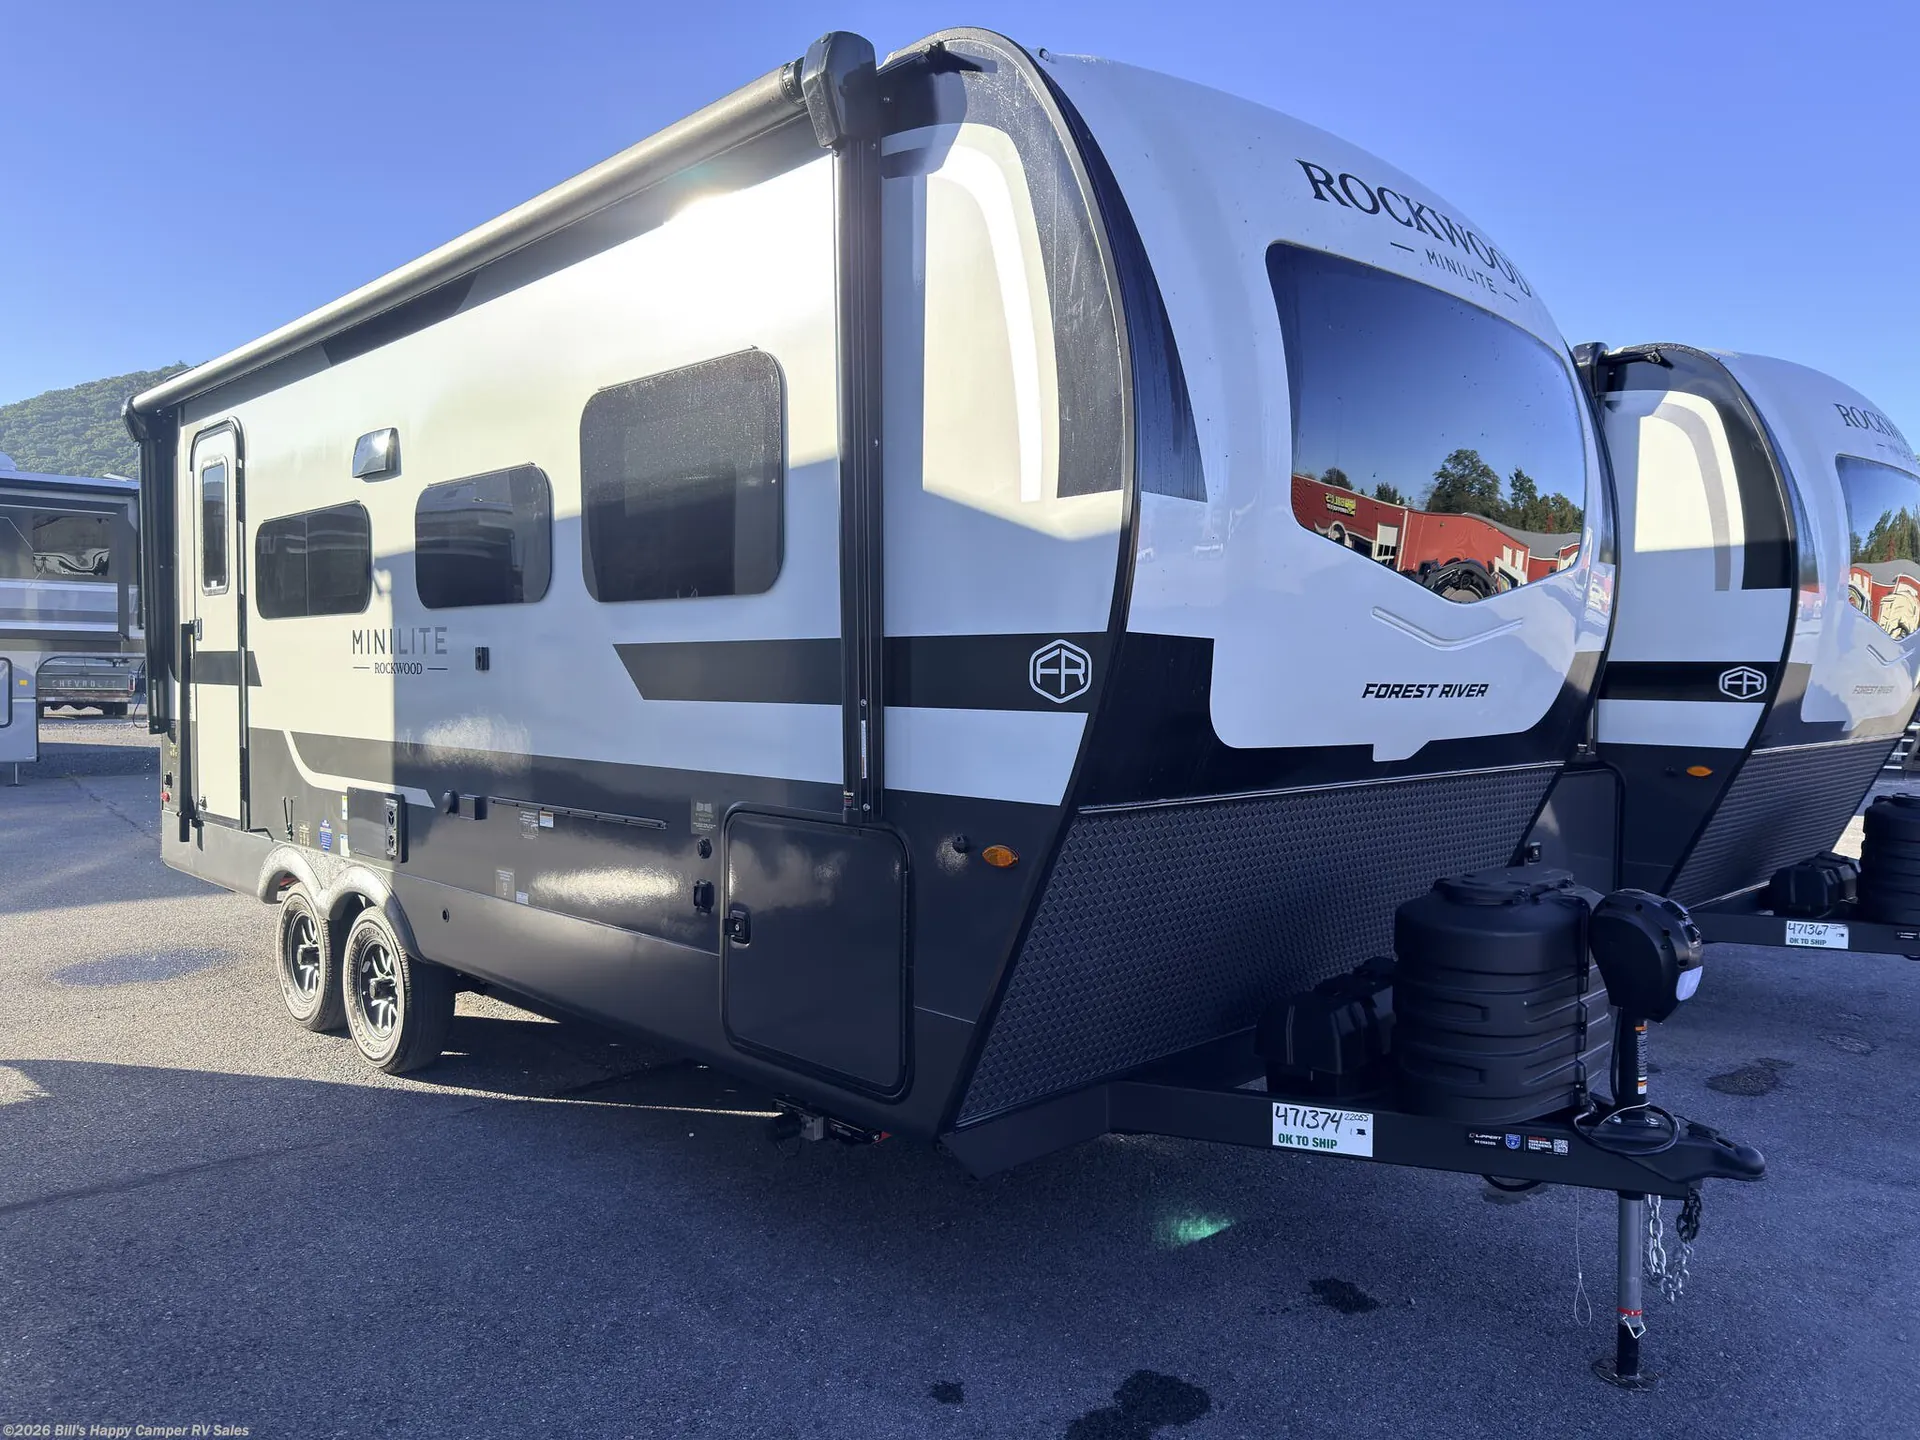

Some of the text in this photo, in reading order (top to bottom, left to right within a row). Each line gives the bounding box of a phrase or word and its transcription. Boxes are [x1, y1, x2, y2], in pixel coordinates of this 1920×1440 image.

[1294, 156, 1532, 298] ROCKWOOD
[1425, 248, 1497, 294] MINILITE
[352, 626, 447, 655] MINILITE
[374, 662, 423, 675] ROCKWOOD
[1361, 683, 1489, 699] FOREST RIVER
[1788, 922, 1829, 935] 471367
[1810, 938, 1827, 946] SHIP
[1275, 1105, 1342, 1134] 471374
[1278, 1132, 1338, 1149] OK TO SHIP
